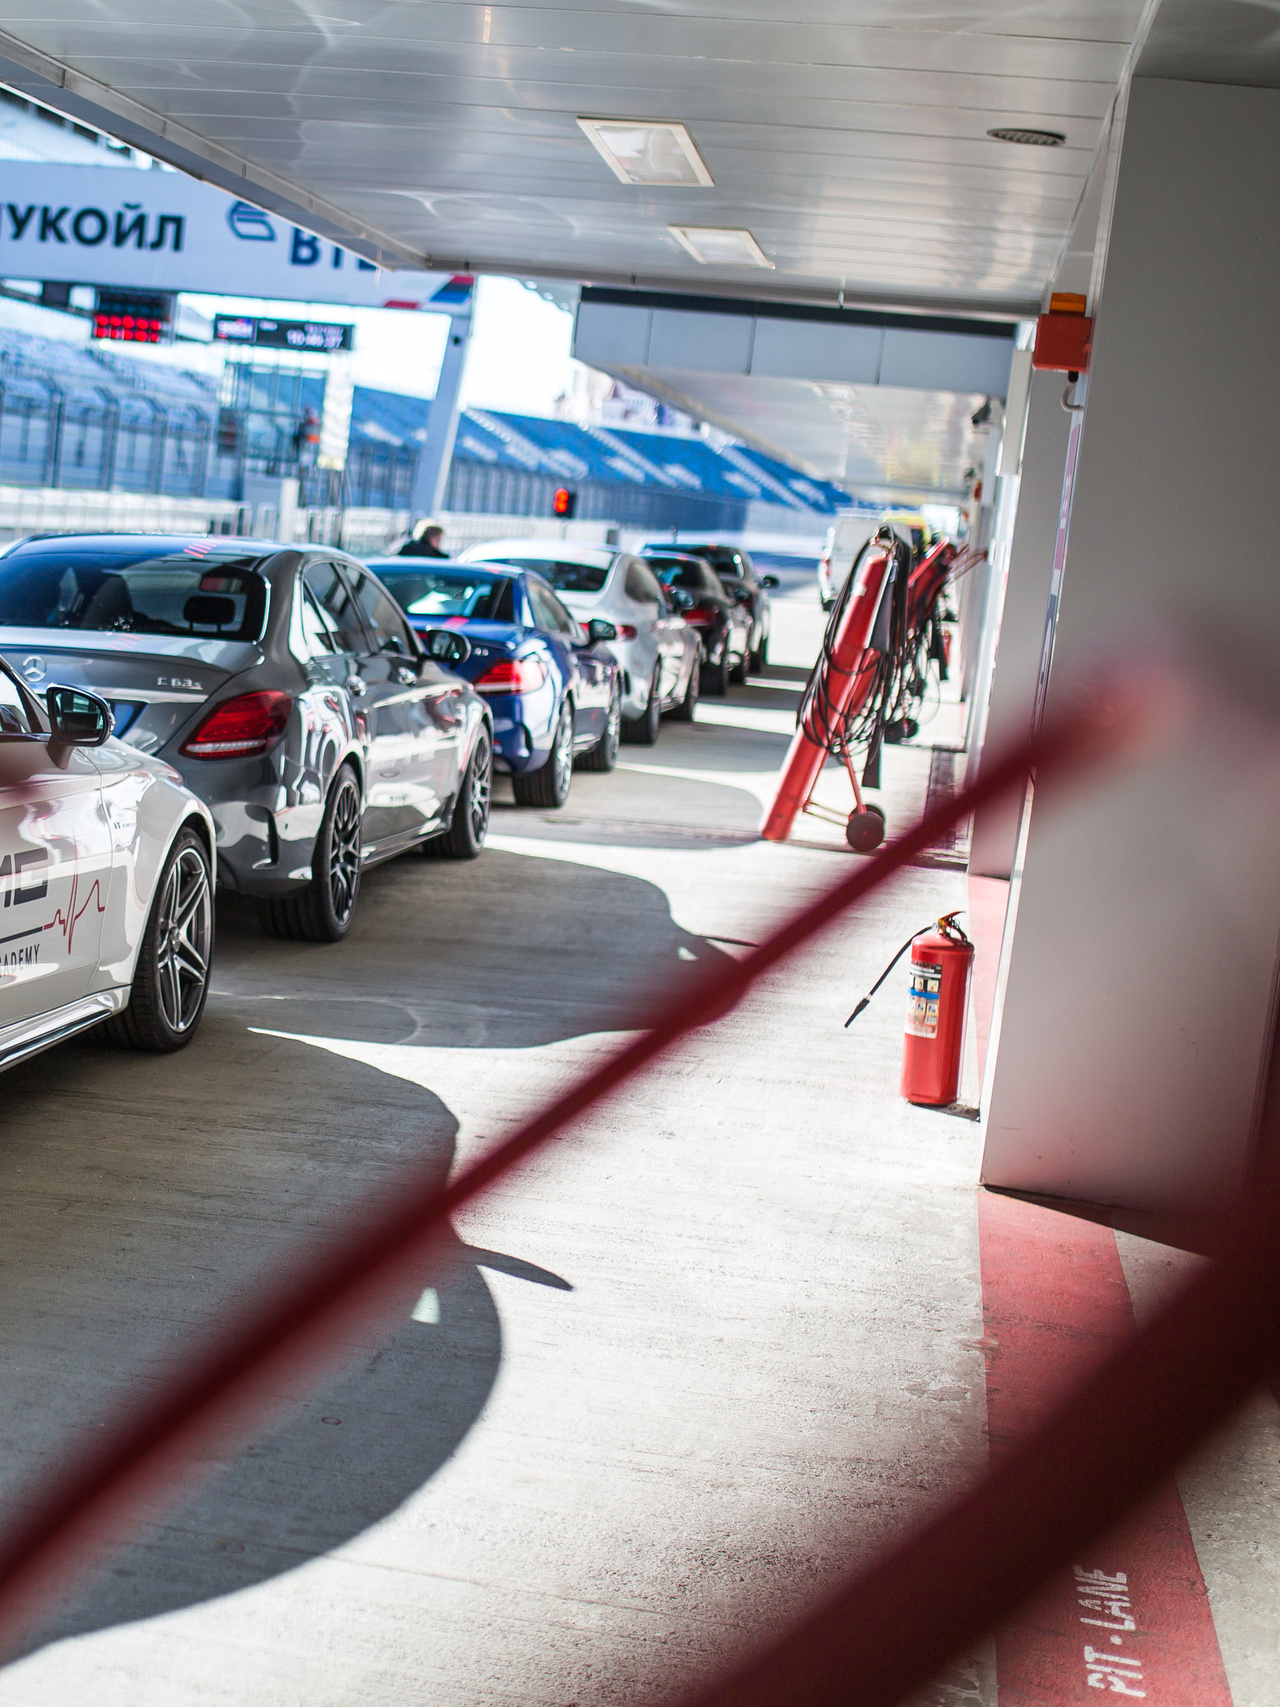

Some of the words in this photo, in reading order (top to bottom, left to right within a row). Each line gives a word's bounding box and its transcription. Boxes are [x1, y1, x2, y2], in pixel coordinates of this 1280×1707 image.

[157, 676, 168, 686] C
[1073, 1564, 1136, 1630] LANE
[1083, 1645, 1146, 1697] PIT
